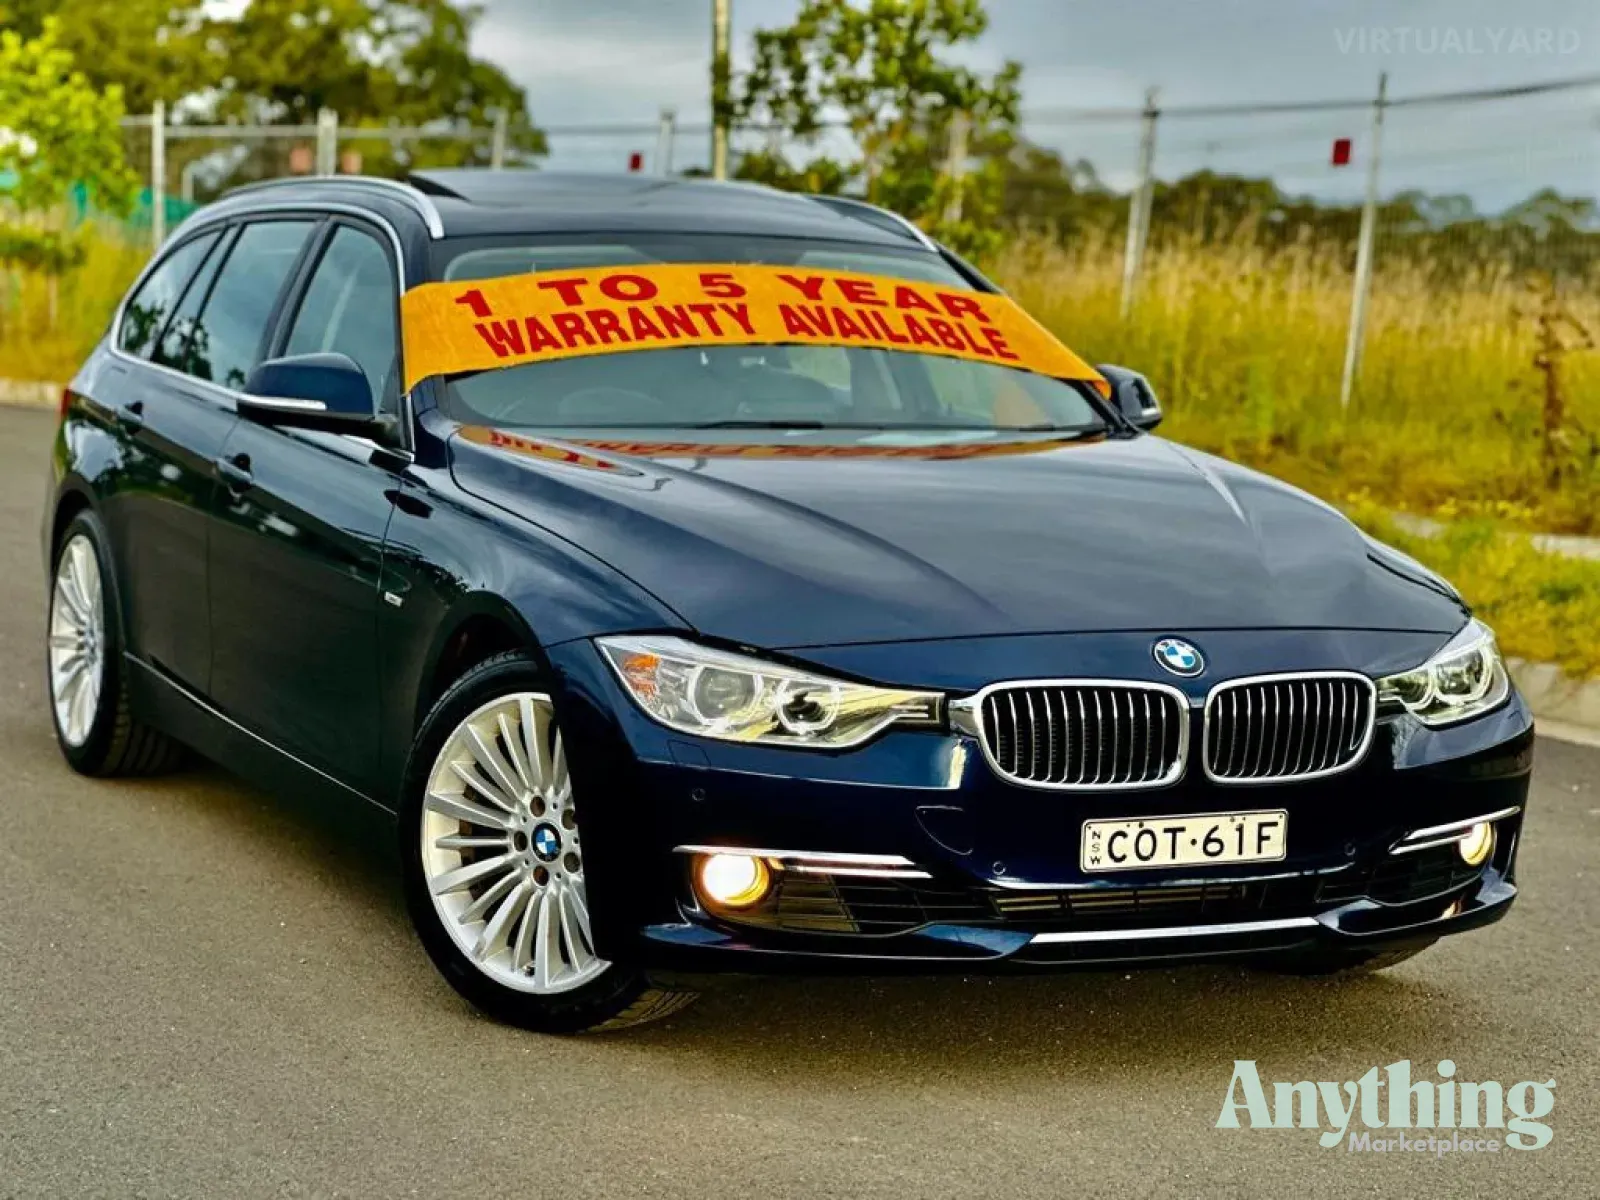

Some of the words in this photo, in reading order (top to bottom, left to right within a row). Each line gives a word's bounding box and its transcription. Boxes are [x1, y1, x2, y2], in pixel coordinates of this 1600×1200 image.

[455, 289, 493, 318] 1
[537, 274, 659, 307] TO
[699, 273, 746, 298] 5
[776, 274, 991, 323] YEAR
[474, 303, 756, 359] WARRANTY
[779, 304, 1020, 360] AVAILABLE
